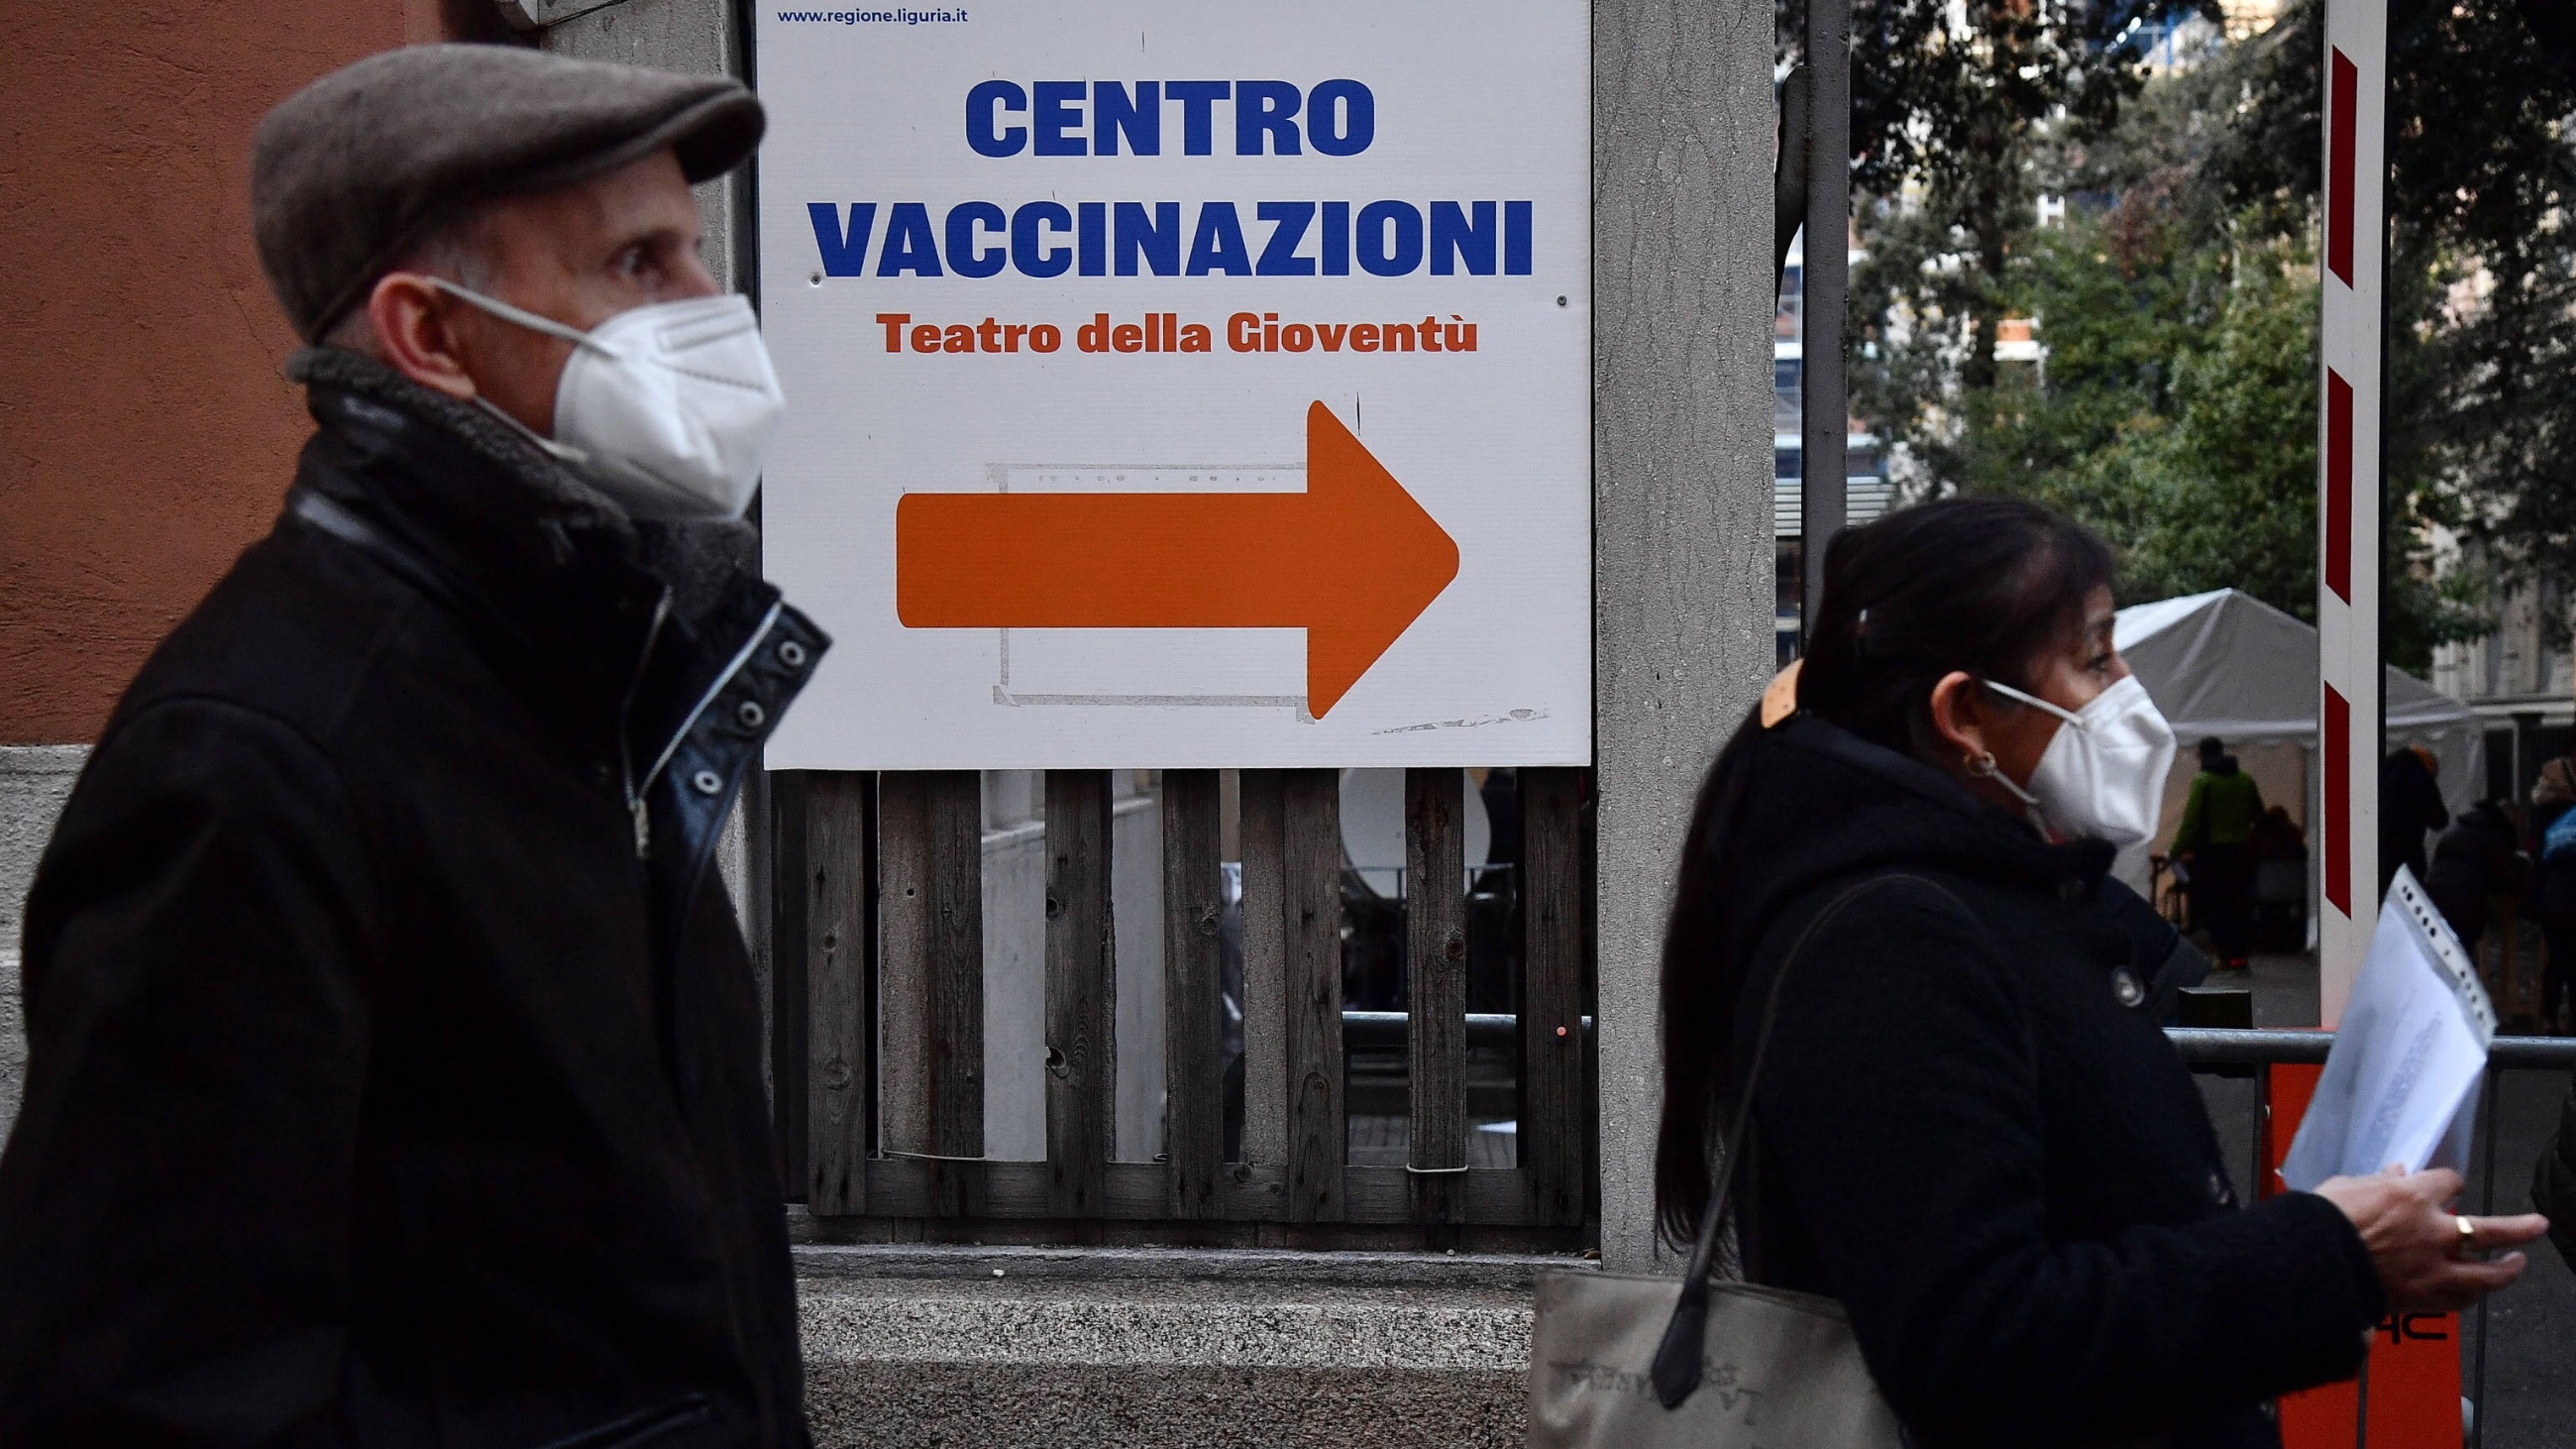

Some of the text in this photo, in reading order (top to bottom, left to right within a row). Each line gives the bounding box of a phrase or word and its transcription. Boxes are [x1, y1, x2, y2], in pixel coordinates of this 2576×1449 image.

[777, 8, 969, 26] www.regione.liguria.it
[965, 78, 1376, 159] CENTRO
[807, 200, 1534, 279] VACCINAZIONI
[876, 312, 1477, 353] Teatro della Gioventù
